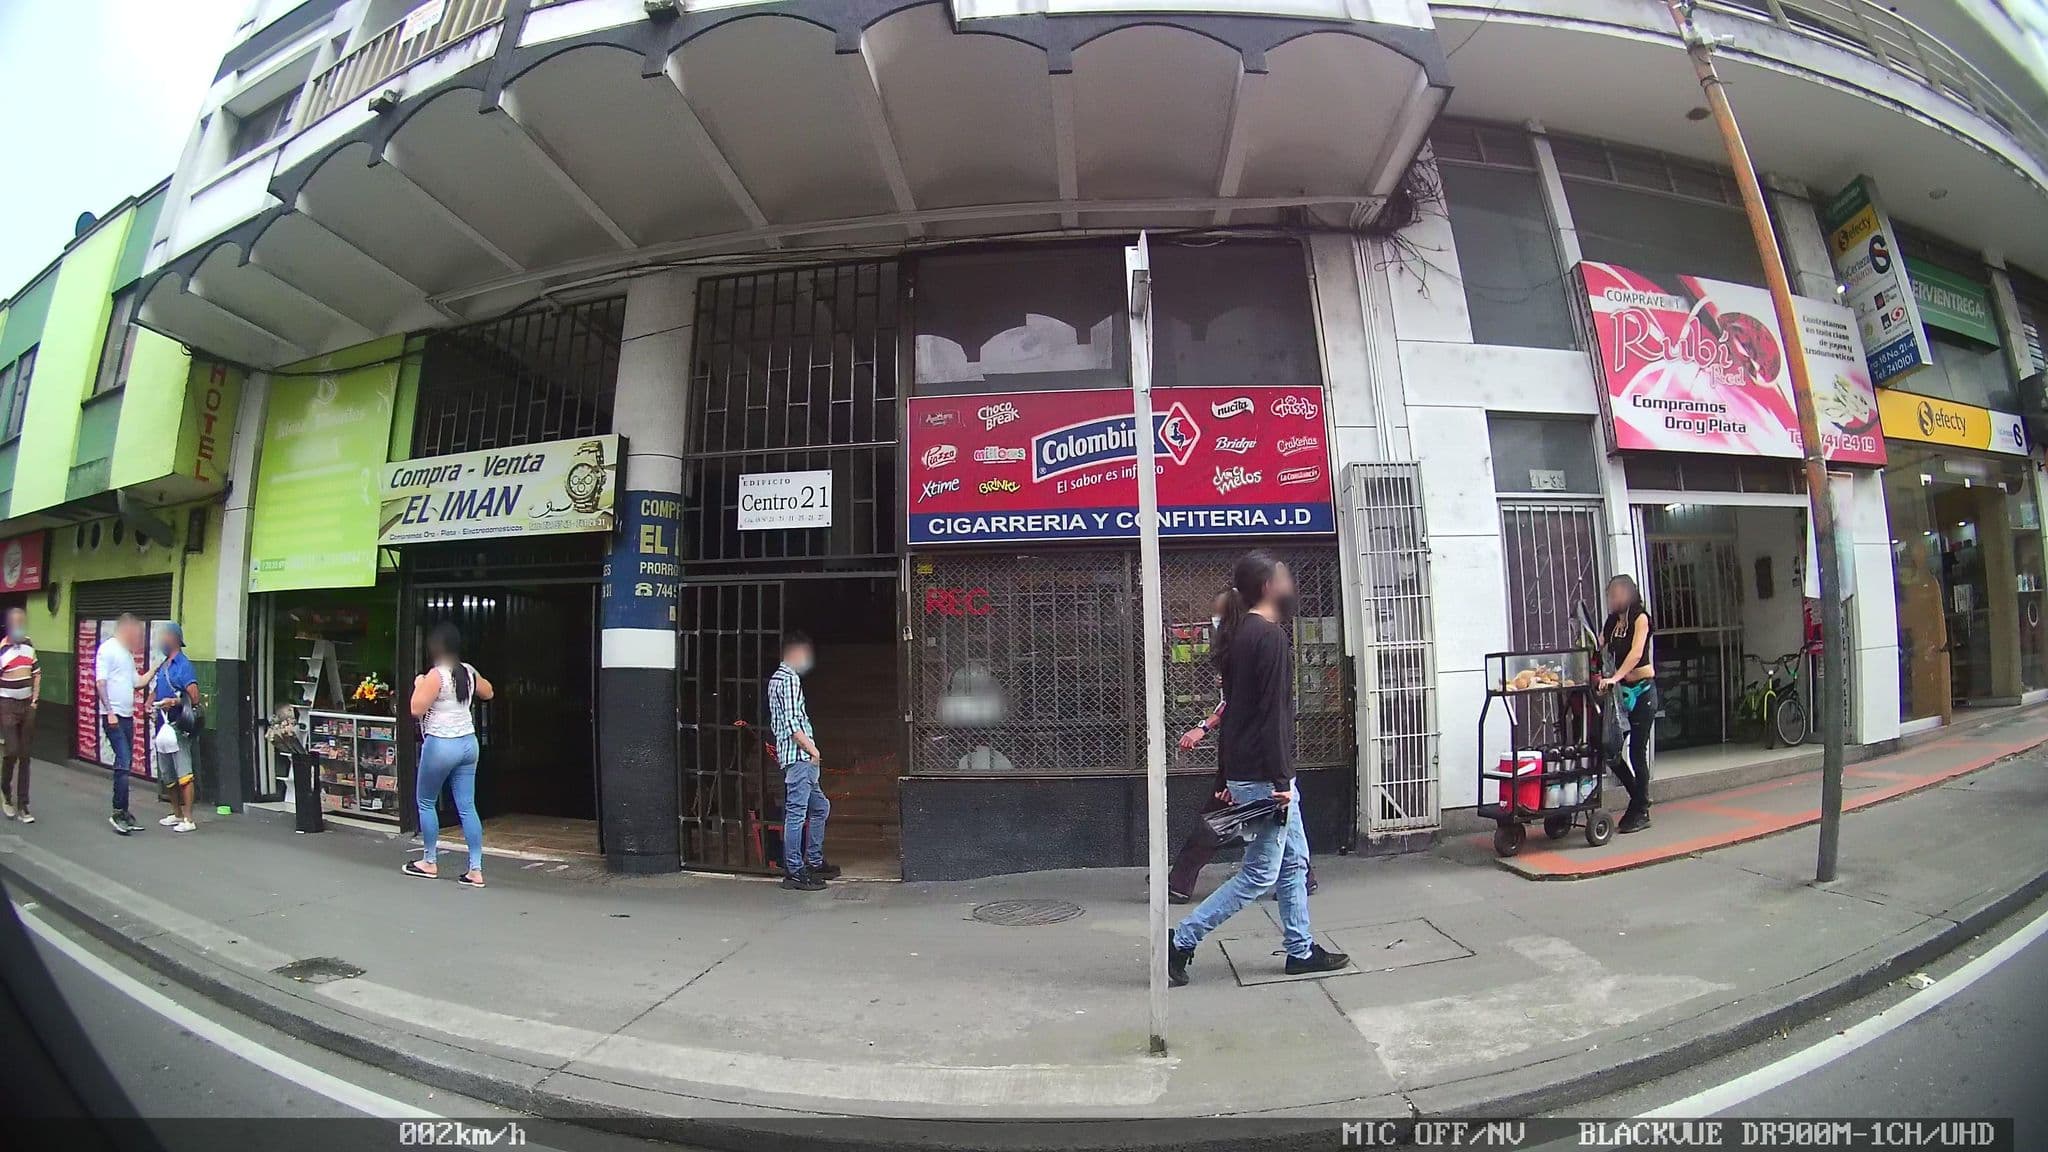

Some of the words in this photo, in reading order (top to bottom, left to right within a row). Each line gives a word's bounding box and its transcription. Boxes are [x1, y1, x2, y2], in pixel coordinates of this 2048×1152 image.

[1912, 281, 1985, 319] ERVIENTREGA
[1610, 308, 1733, 372] Rubí
[1710, 364, 1746, 387] Red
[977, 401, 1014, 420] Choco
[1217, 400, 1249, 416] nucita
[1632, 394, 1728, 414] Compramos
[195, 362, 227, 482] HOTEL
[985, 408, 1021, 432] Break
[1665, 416, 1694, 431] Oro
[1696, 420, 1705, 435] y
[1708, 418, 1747, 434] Plata
[1934, 408, 1966, 437] efecty
[1042, 422, 1138, 465] Colombin
[1842, 435, 1860, 452] 24
[1862, 437, 1876, 453] 19
[922, 444, 959, 471] Piazza
[390, 462, 463, 490] Compra
[482, 453, 546, 478] Venta
[743, 477, 792, 487] EDIFICIO
[1056, 480, 1068, 494] El
[1070, 472, 1103, 491] sabor
[1105, 470, 1118, 481] es
[741, 493, 798, 512] Centro
[799, 485, 830, 509] 21
[918, 475, 960, 504] Xtime
[401, 494, 432, 525] EL
[439, 484, 524, 521] IMAN
[928, 512, 1088, 535] CIGARRERIA
[1091, 511, 1110, 530] Y
[1273, 507, 1312, 526] J.D
[640, 523, 669, 556] EL
